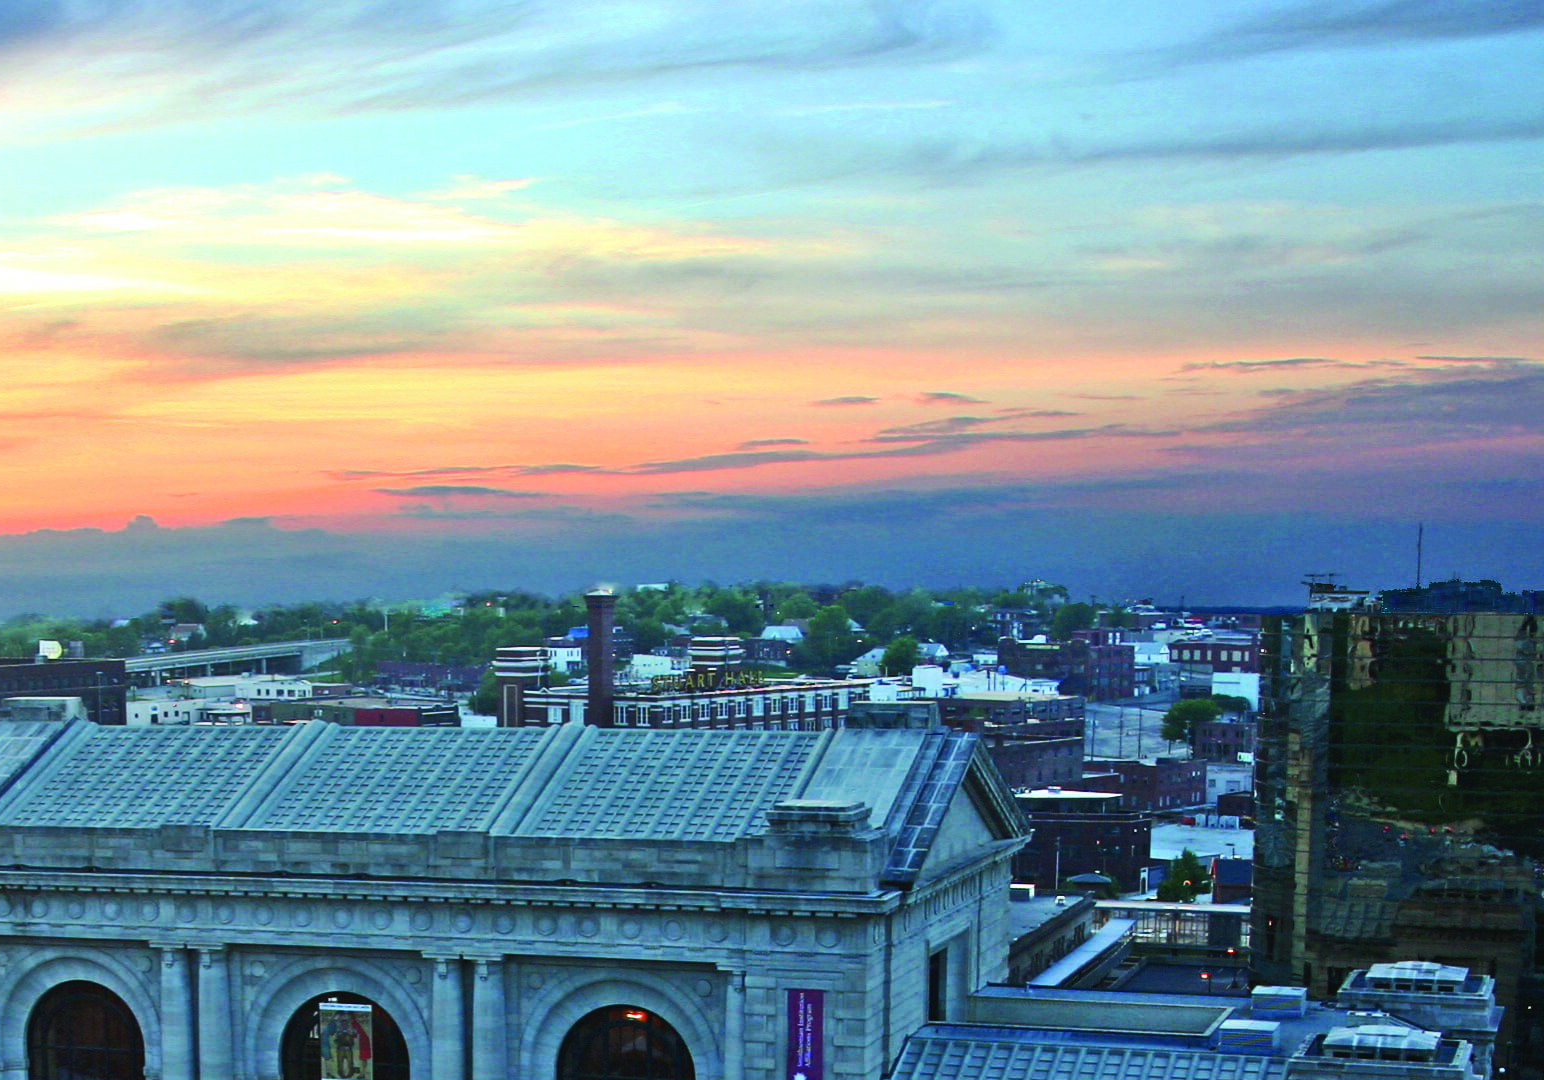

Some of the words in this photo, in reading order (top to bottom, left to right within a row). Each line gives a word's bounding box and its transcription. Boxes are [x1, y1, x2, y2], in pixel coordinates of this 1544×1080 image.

[652, 673, 716, 690] STUART
[725, 671, 764, 685] HALL
[805, 1003, 813, 1032] Program
[804, 1033, 812, 1068] Affiliations
